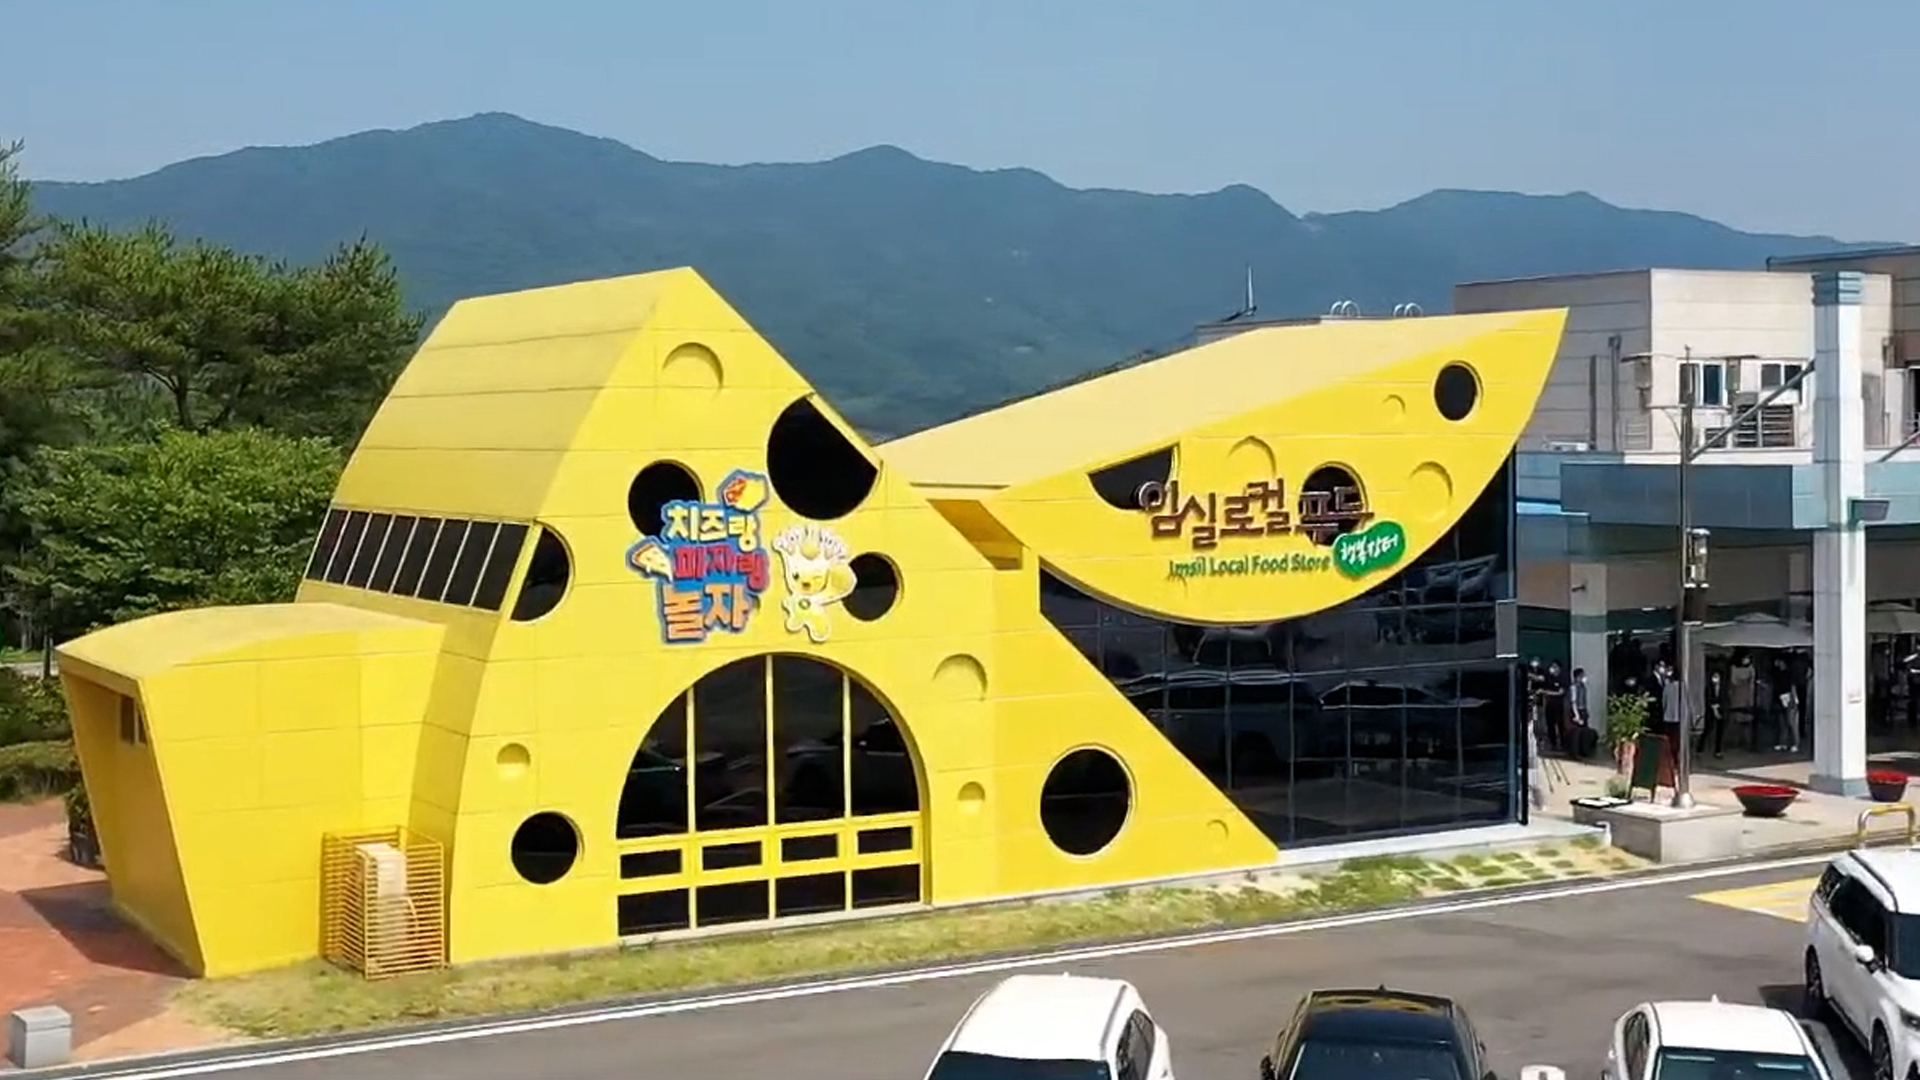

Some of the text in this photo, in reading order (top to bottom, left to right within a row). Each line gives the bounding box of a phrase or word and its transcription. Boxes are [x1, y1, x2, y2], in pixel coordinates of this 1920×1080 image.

[667, 506, 757, 552] 치즈랑
[1169, 551, 1331, 577] Imsil Local Food Store
[664, 583, 752, 641] 놀자
